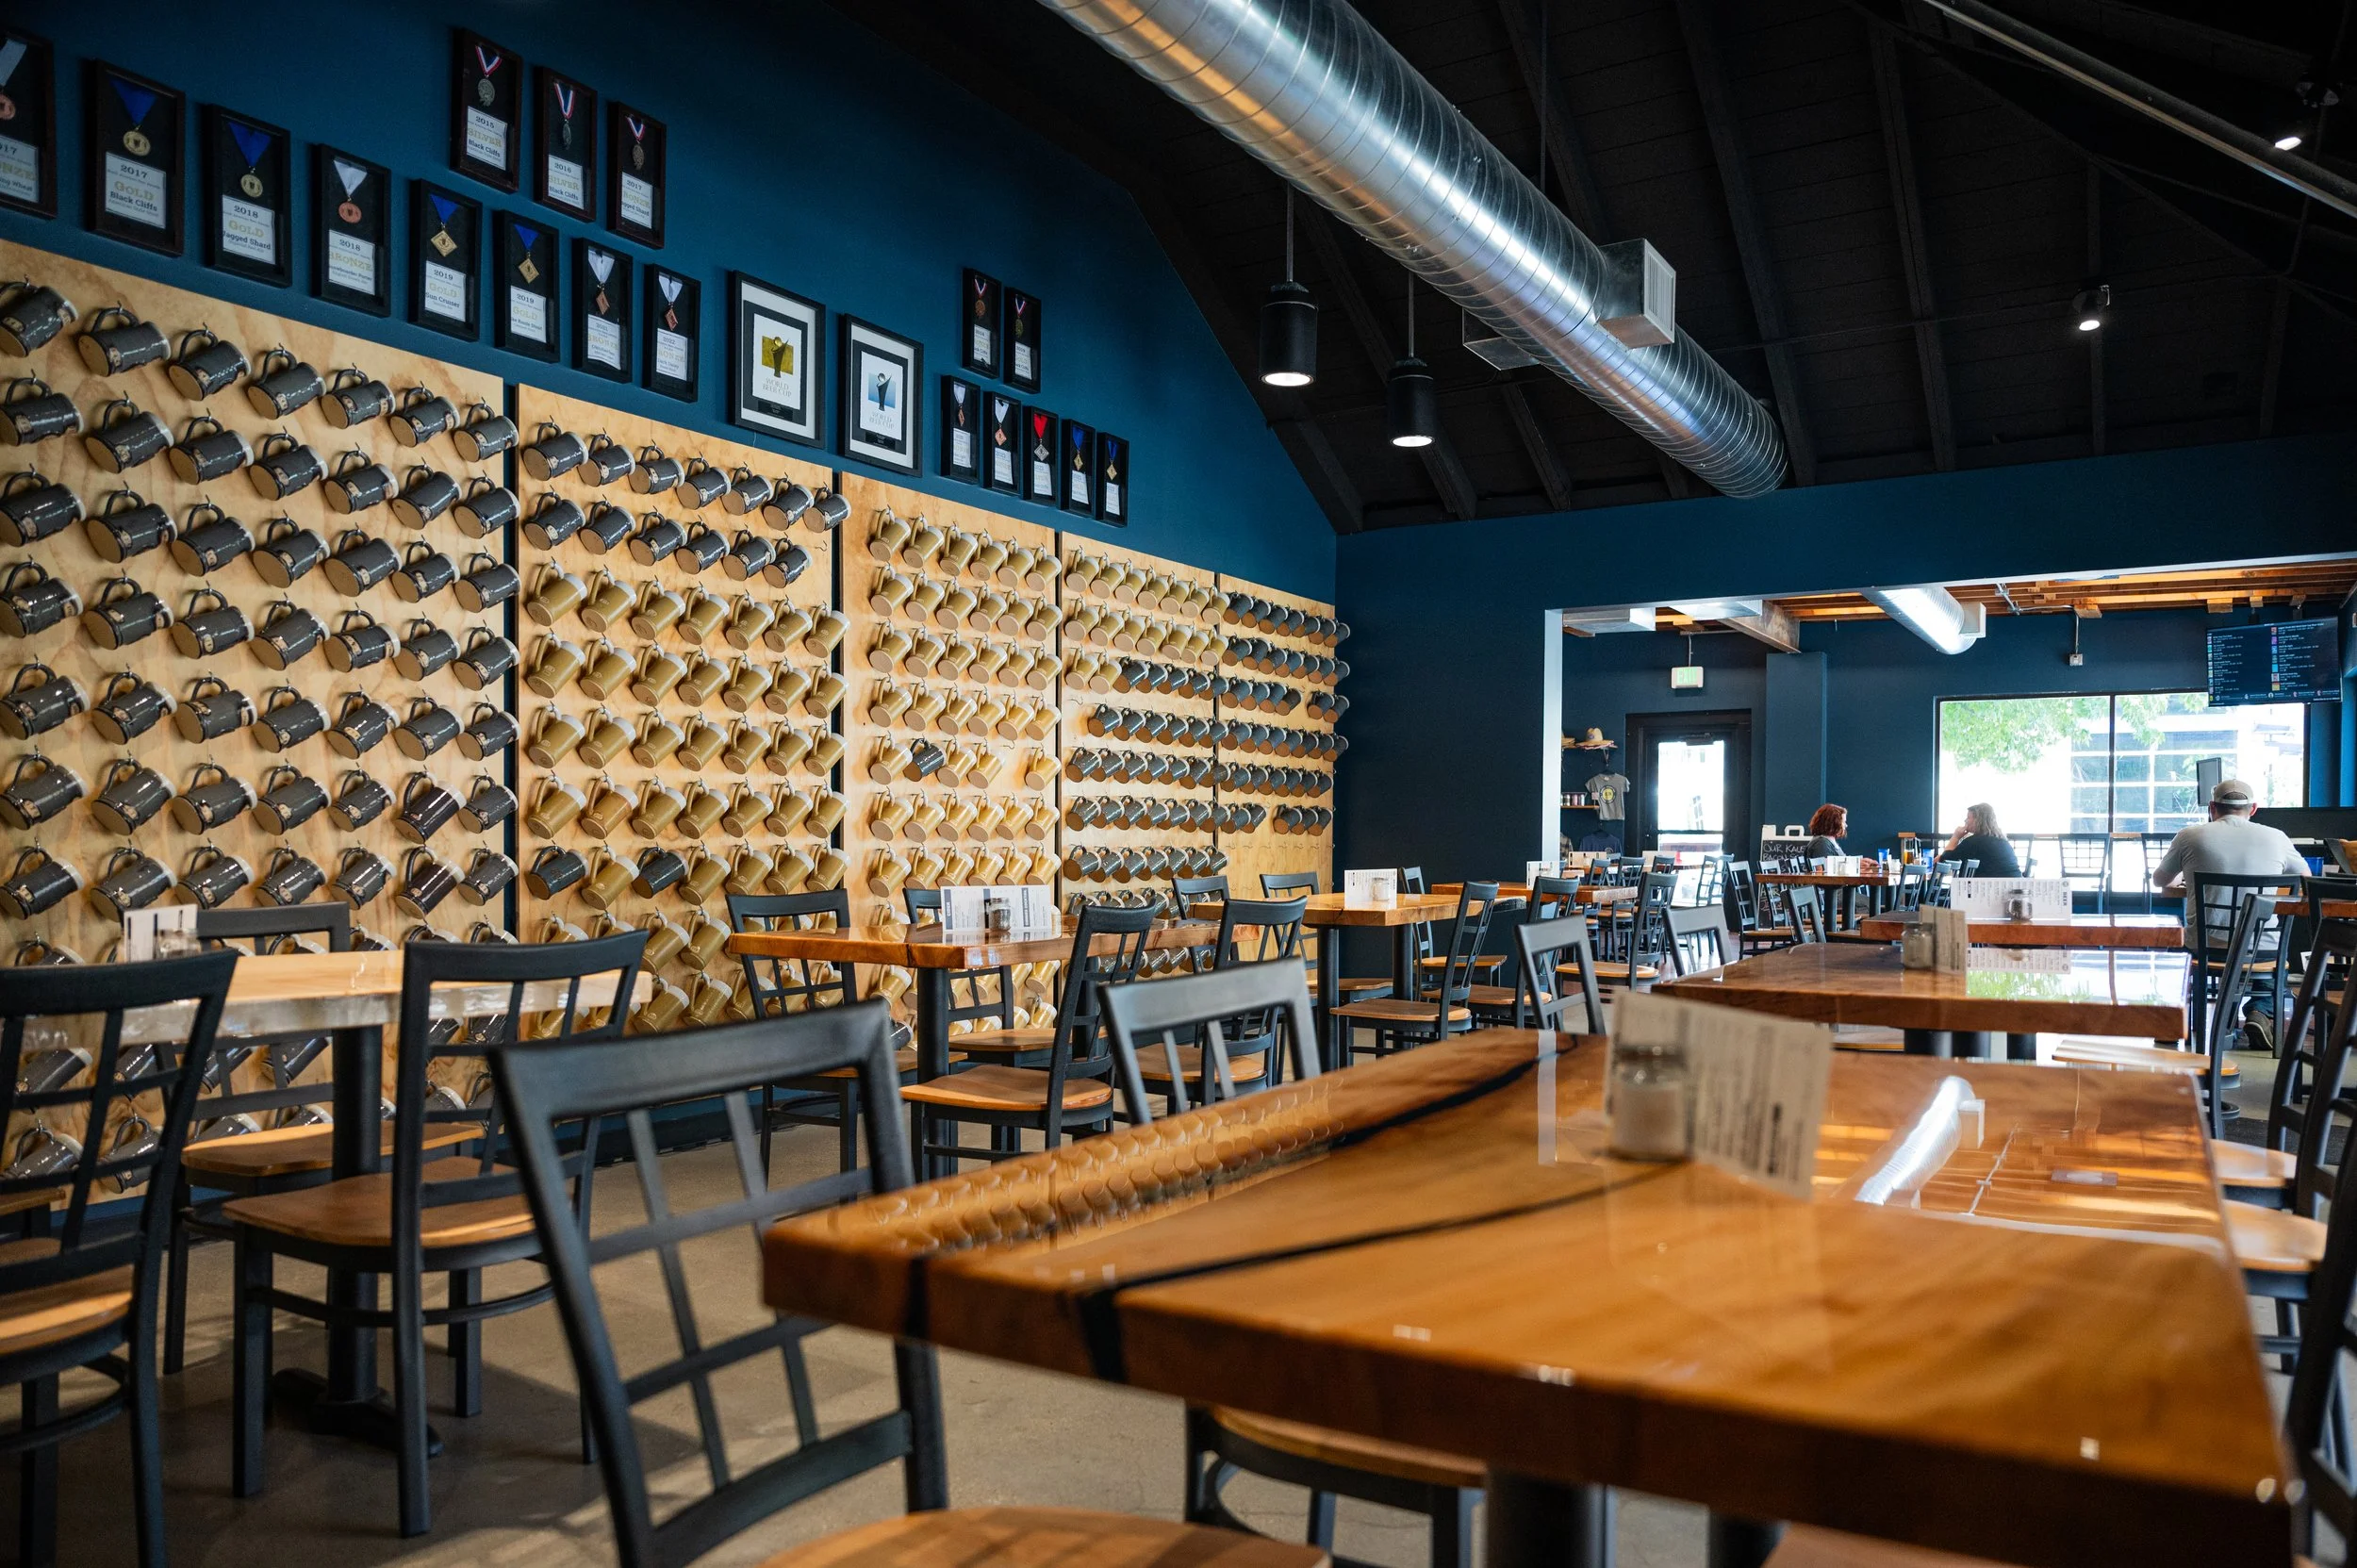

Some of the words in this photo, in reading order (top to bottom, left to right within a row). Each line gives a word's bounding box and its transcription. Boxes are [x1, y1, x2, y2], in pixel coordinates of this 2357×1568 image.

[475, 116, 495, 129] 2015
[469, 140, 484, 151] Black
[485, 146, 501, 157] Cliffs
[120, 164, 148, 179] 2017
[554, 162, 571, 173] 2016
[114, 180, 156, 201] GOLD
[109, 191, 134, 205] Black
[135, 197, 157, 212] Cliffs
[234, 205, 258, 219] 2018
[228, 219, 265, 239] GOLD
[223, 231, 248, 244] Jagged
[249, 238, 272, 251] Shard
[339, 239, 361, 252] 2018
[434, 270, 453, 281] 2019
[429, 282, 458, 299] GOLD
[517, 293, 535, 305] 2019
[512, 305, 538, 321] GOLD
[766, 377, 789, 390] WORLD
[1677, 668, 1697, 685] EXIT
[1763, 843, 1783, 853] OUR
[1785, 843, 1806, 853] KALE
